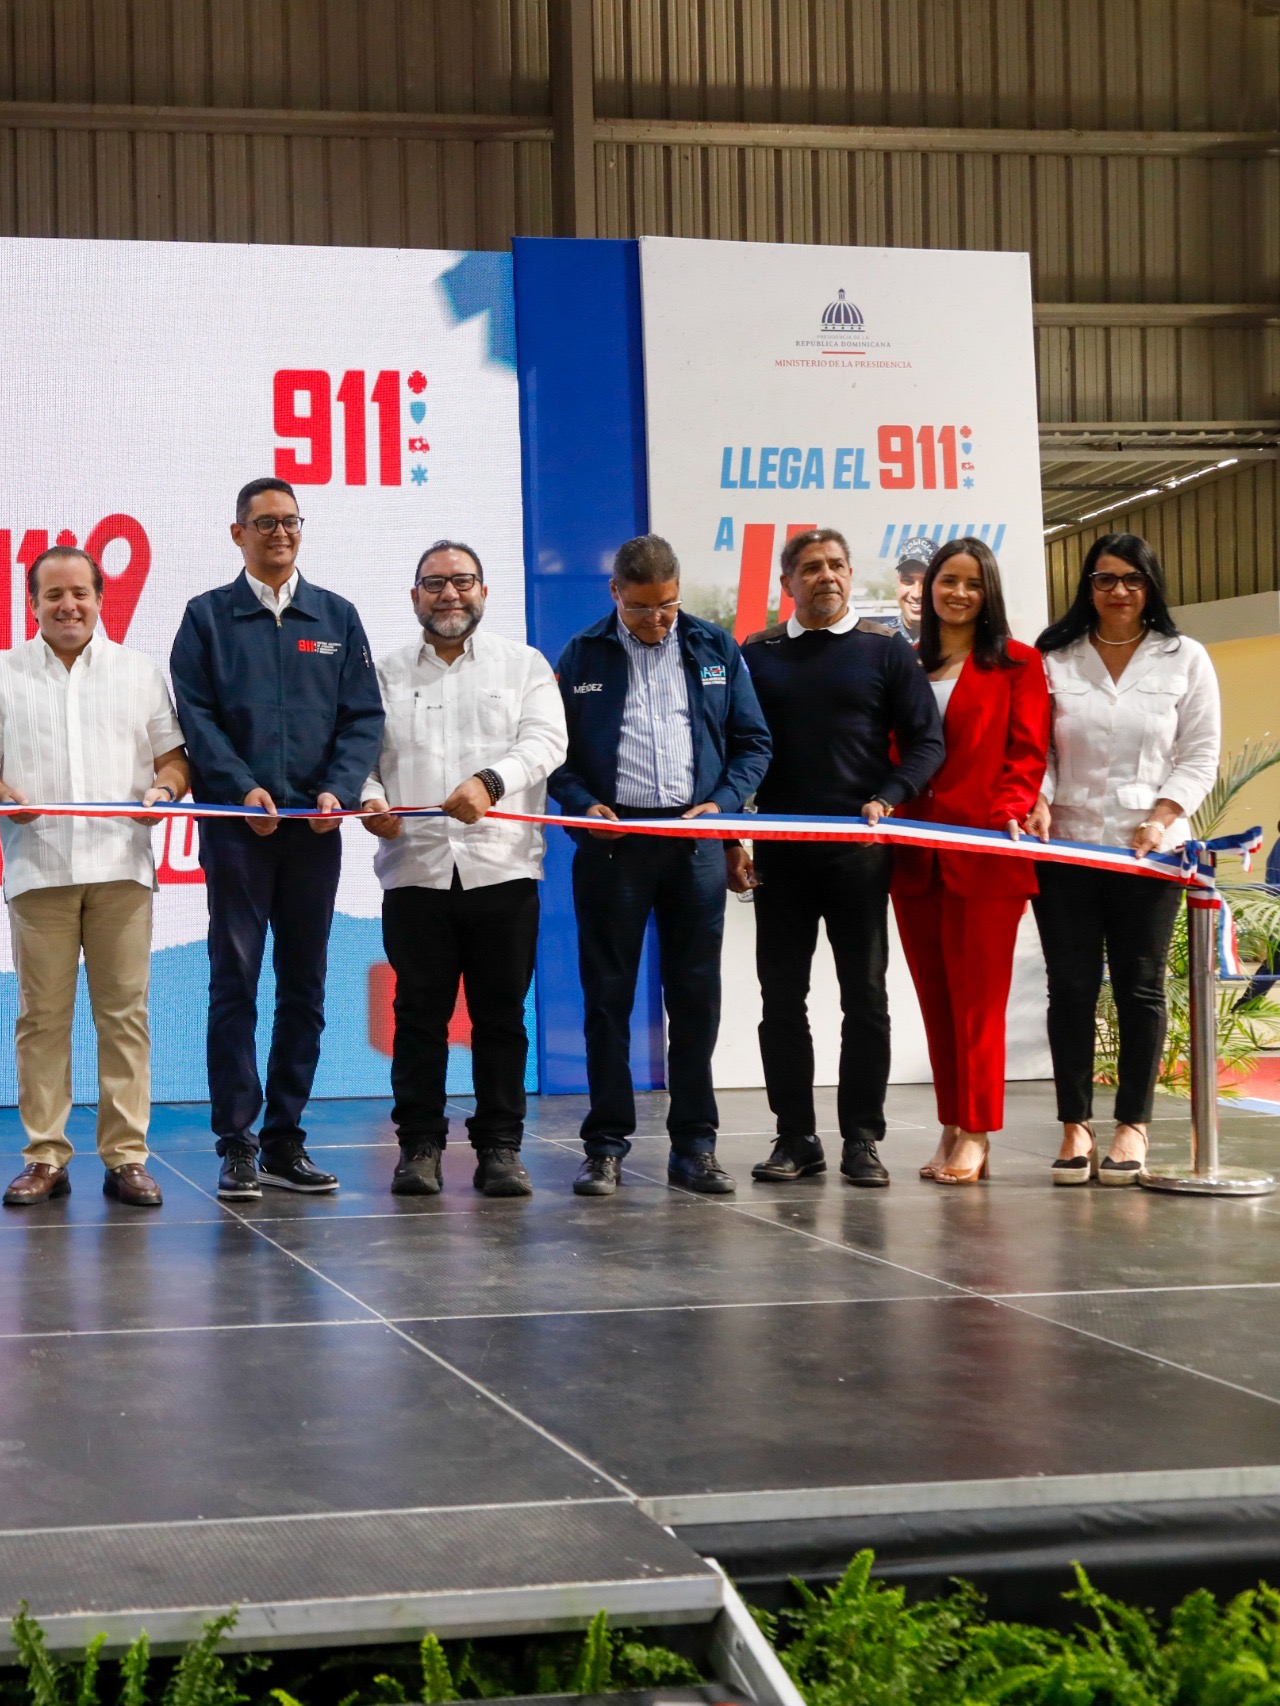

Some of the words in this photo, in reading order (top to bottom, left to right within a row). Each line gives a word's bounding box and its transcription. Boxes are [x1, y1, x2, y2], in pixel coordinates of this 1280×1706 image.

[774, 359, 827, 368] MINISTERIO
[828, 360, 840, 368] DE
[841, 360, 854, 368] LA
[855, 360, 913, 369] PRESIDENCIA
[272, 369, 402, 486] 911
[720, 446, 825, 489] LLEGA
[832, 447, 871, 490] EL
[877, 424, 959, 490] 911
[713, 516, 735, 551] A
[297, 639, 315, 653] 911
